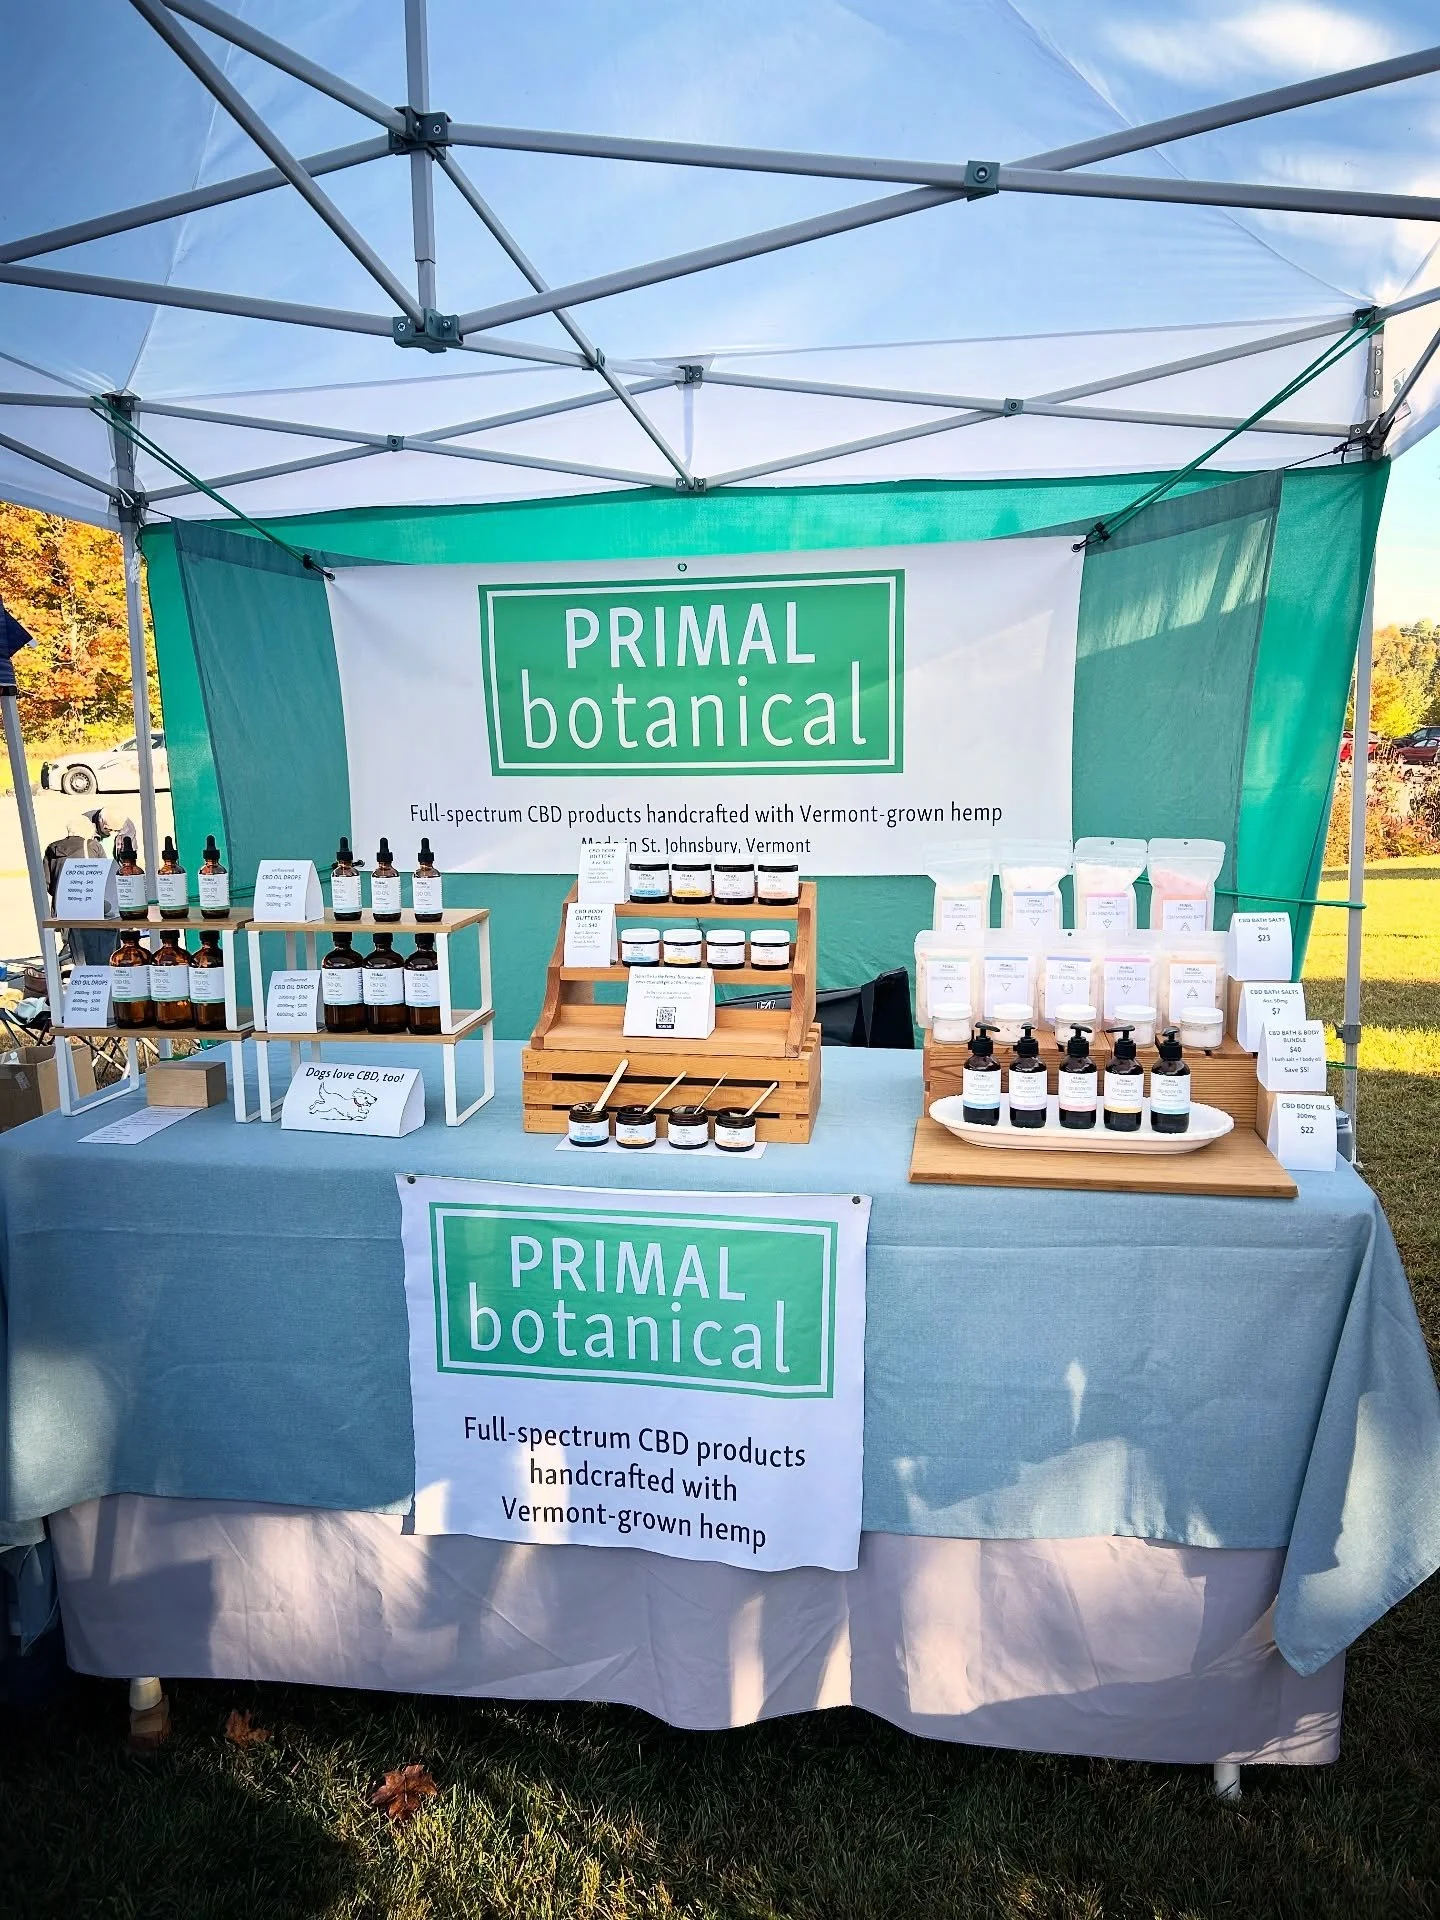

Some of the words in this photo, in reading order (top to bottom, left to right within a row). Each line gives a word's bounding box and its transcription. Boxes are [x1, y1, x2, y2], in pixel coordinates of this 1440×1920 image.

[564, 601, 817, 669] PRIMAL
[521, 661, 867, 750] botanical
[410, 802, 522, 827] Full-spectrum
[528, 805, 562, 823] CBD
[568, 803, 641, 828] products
[647, 803, 749, 824] handcrafted
[755, 803, 794, 823] with
[800, 804, 944, 828] Vermont-grown
[951, 801, 1002, 826] hemp
[642, 837, 660, 853] St.
[665, 836, 741, 854] Johnsbury,
[746, 836, 811, 853] Vermont
[1258, 934, 1271, 942] $23
[1272, 1008, 1281, 1016] $7
[306, 1067, 331, 1081] Dogs
[332, 1068, 355, 1080] love
[356, 1070, 380, 1082] CBD,
[382, 1073, 405, 1083] too!
[1300, 1066, 1310, 1074] $5!
[1300, 1126, 1315, 1134] $22
[509, 1234, 747, 1302] PRIMAL
[468, 1281, 791, 1374] botanical
[464, 1415, 631, 1452] Full-spectrum
[638, 1427, 689, 1456] CBD
[697, 1437, 806, 1468] products
[530, 1458, 675, 1496] handcrafted
[682, 1474, 737, 1503] with
[501, 1495, 692, 1537] Vermont-grown
[700, 1512, 767, 1554] hemp
